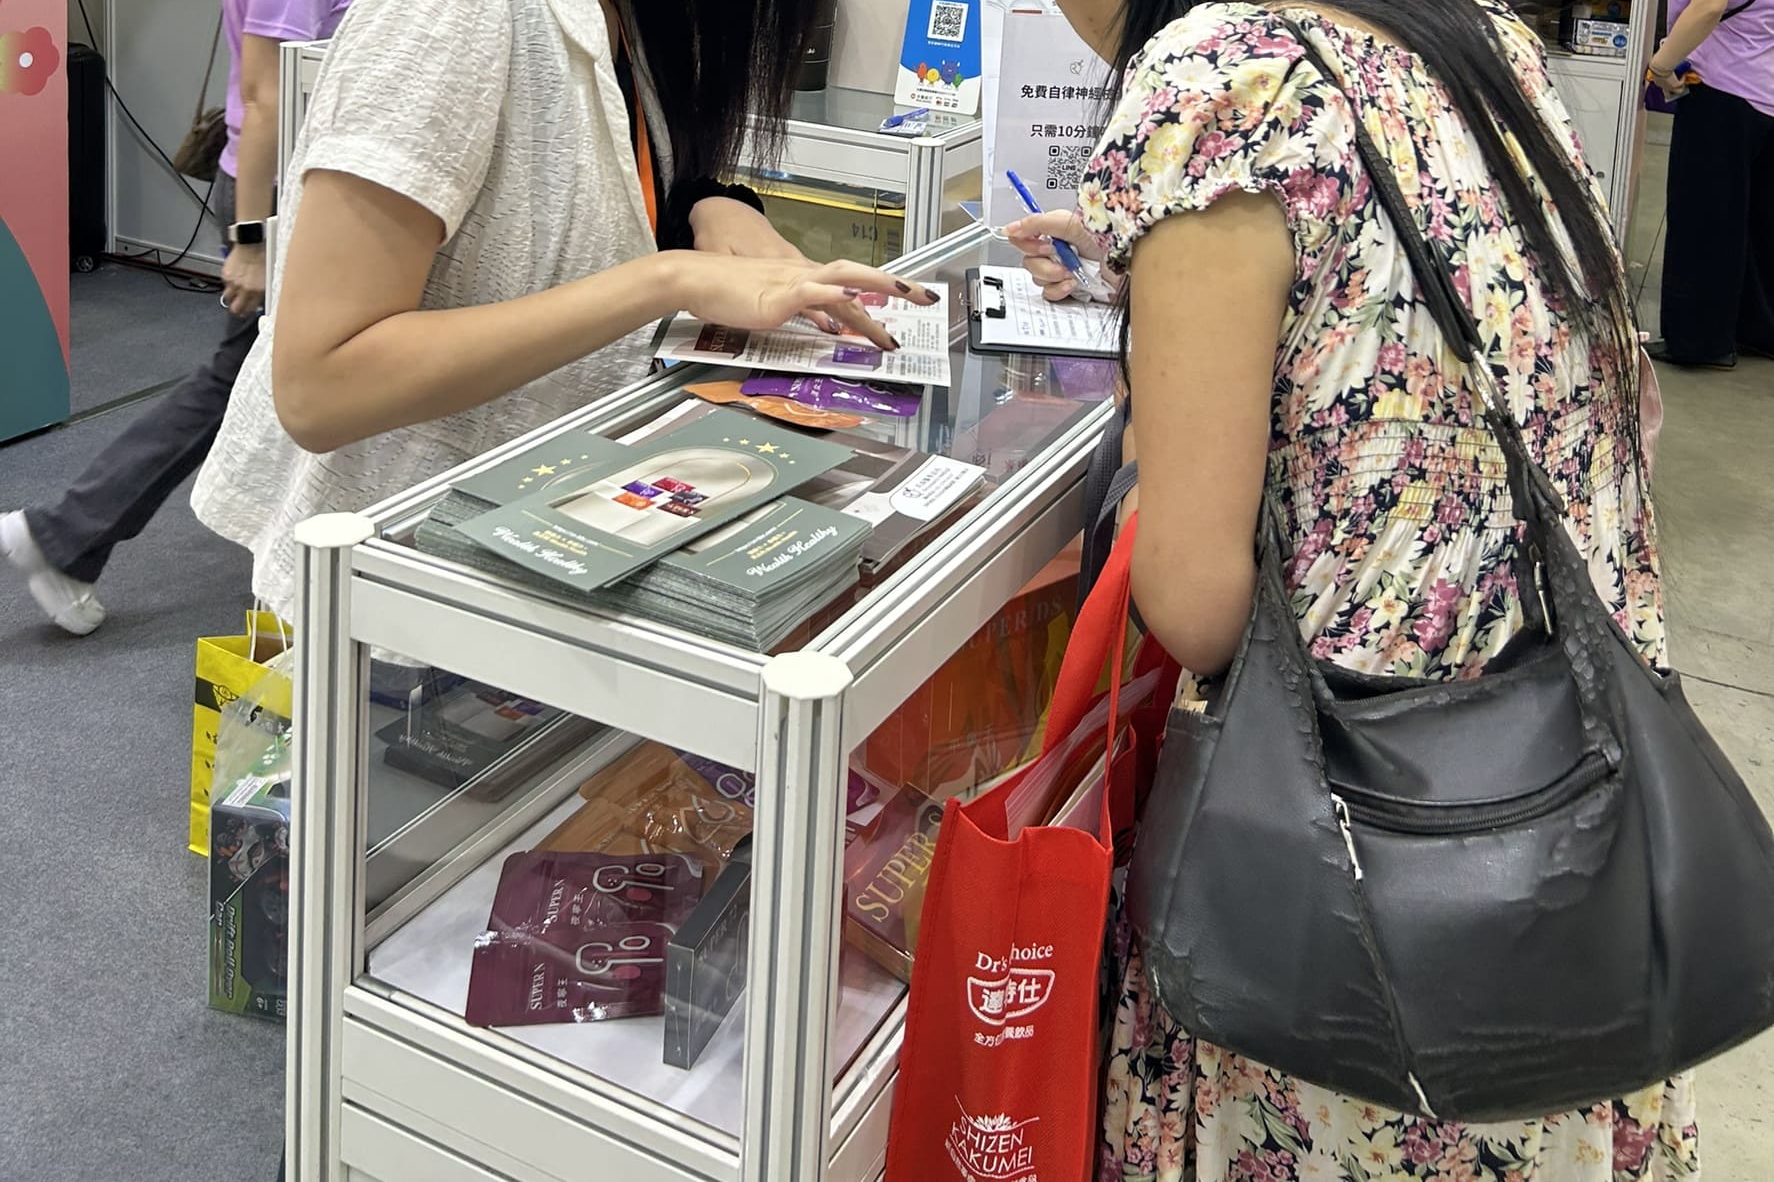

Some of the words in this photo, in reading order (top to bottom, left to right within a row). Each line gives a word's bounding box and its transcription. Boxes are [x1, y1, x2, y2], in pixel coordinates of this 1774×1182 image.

[787, 525, 838, 555] Healthy
[856, 832, 937, 922] SUPER
[975, 951, 1008, 973] Dr's
[1008, 942, 1054, 964] hoice
[530, 971, 545, 1010] SUPER
[951, 1121, 1033, 1174] KAKUMEI
[960, 1116, 1024, 1154] SHIZEN
